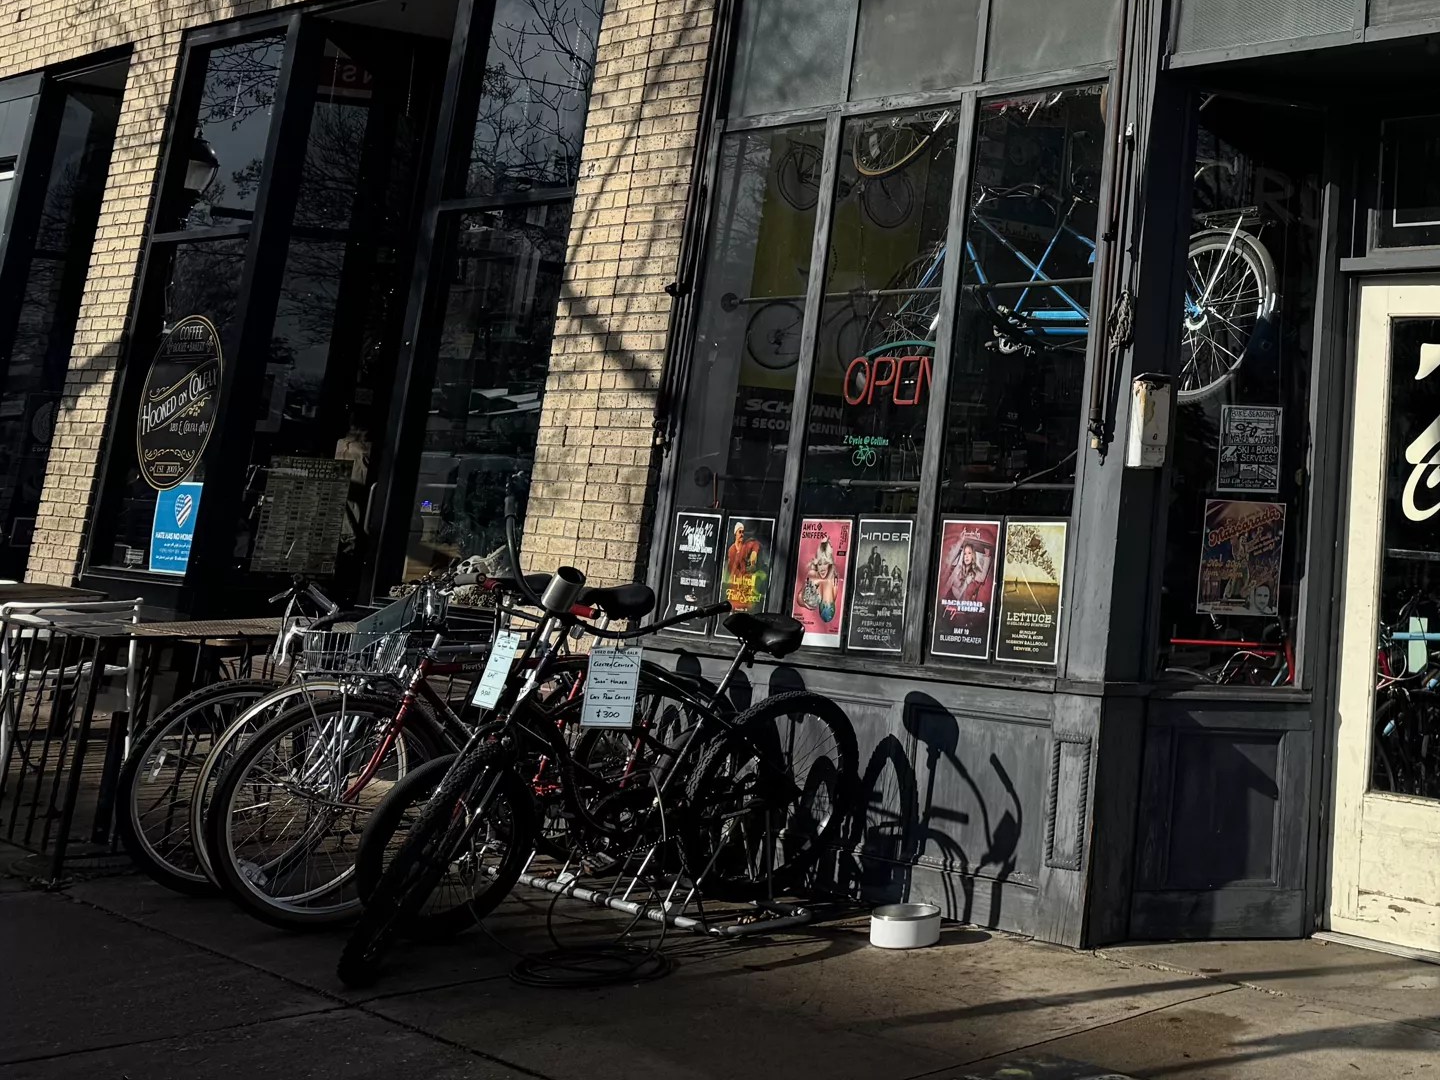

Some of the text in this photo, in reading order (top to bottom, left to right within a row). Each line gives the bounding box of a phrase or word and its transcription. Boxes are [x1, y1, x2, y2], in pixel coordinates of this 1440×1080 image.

[179, 325, 204, 340] COFFEE
[843, 356, 933, 406] OPEN
[843, 435, 849, 444] Z
[849, 435, 863, 446] Cycle
[870, 436, 889, 446] Collins
[1236, 445, 1250, 454] SKI
[1256, 446, 1278, 454] BOARD
[1006, 612, 1052, 623] LETTUCE
[939, 634, 982, 644] BLUEBIRD THEATER
